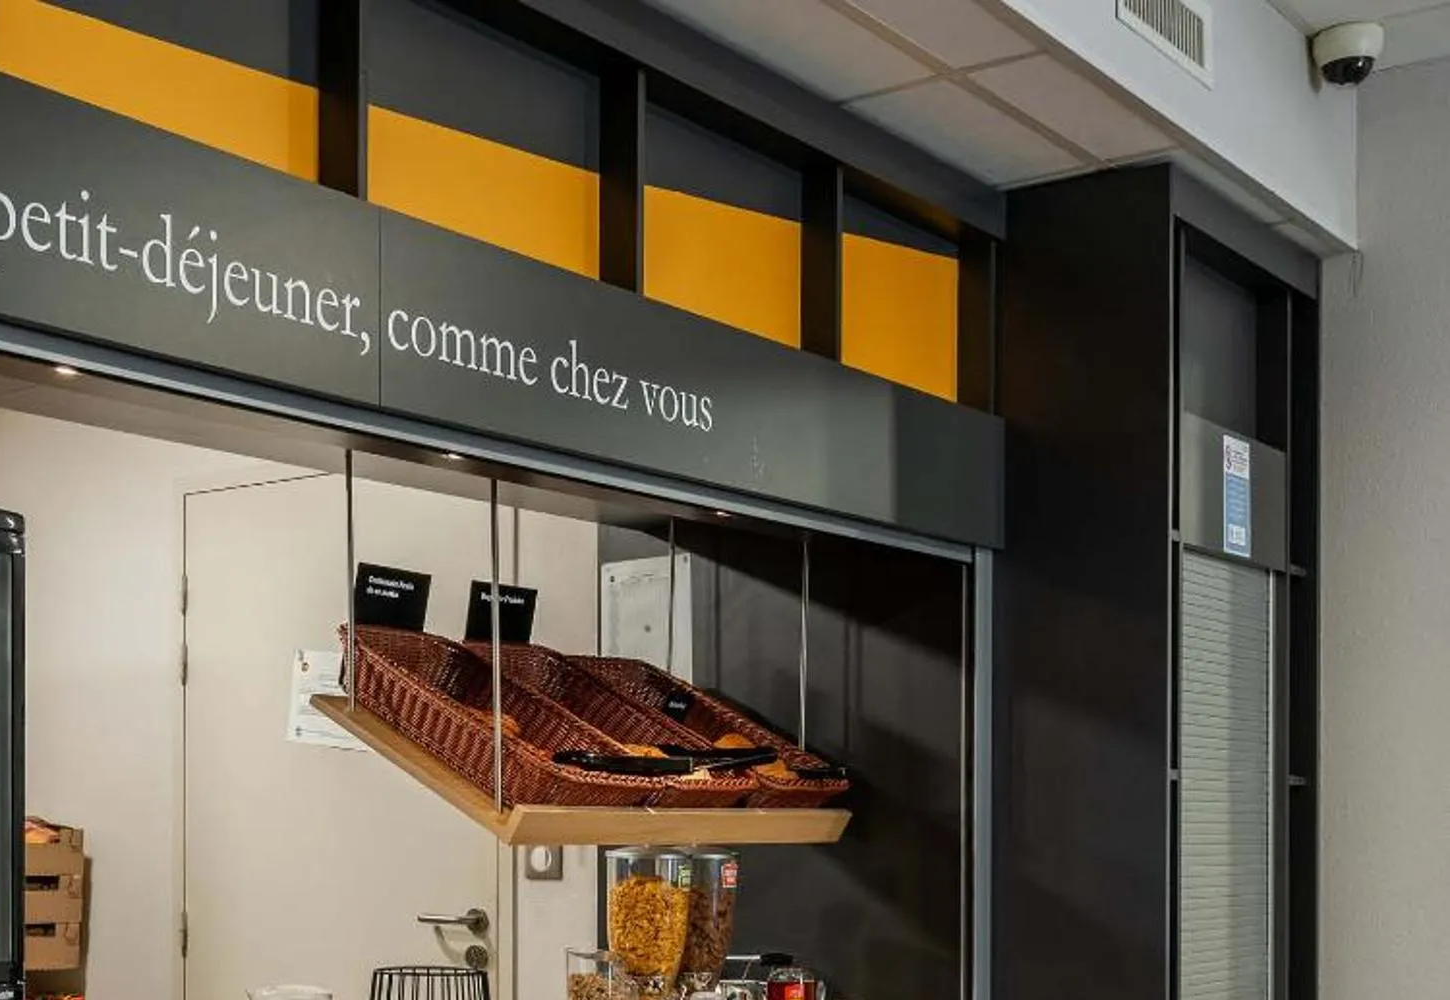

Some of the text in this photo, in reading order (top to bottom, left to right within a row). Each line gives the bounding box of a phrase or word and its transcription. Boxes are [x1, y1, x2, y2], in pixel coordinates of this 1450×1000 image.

[387, 309, 539, 386] comme
[550, 339, 630, 410] chez
[639, 379, 714, 432] vous
